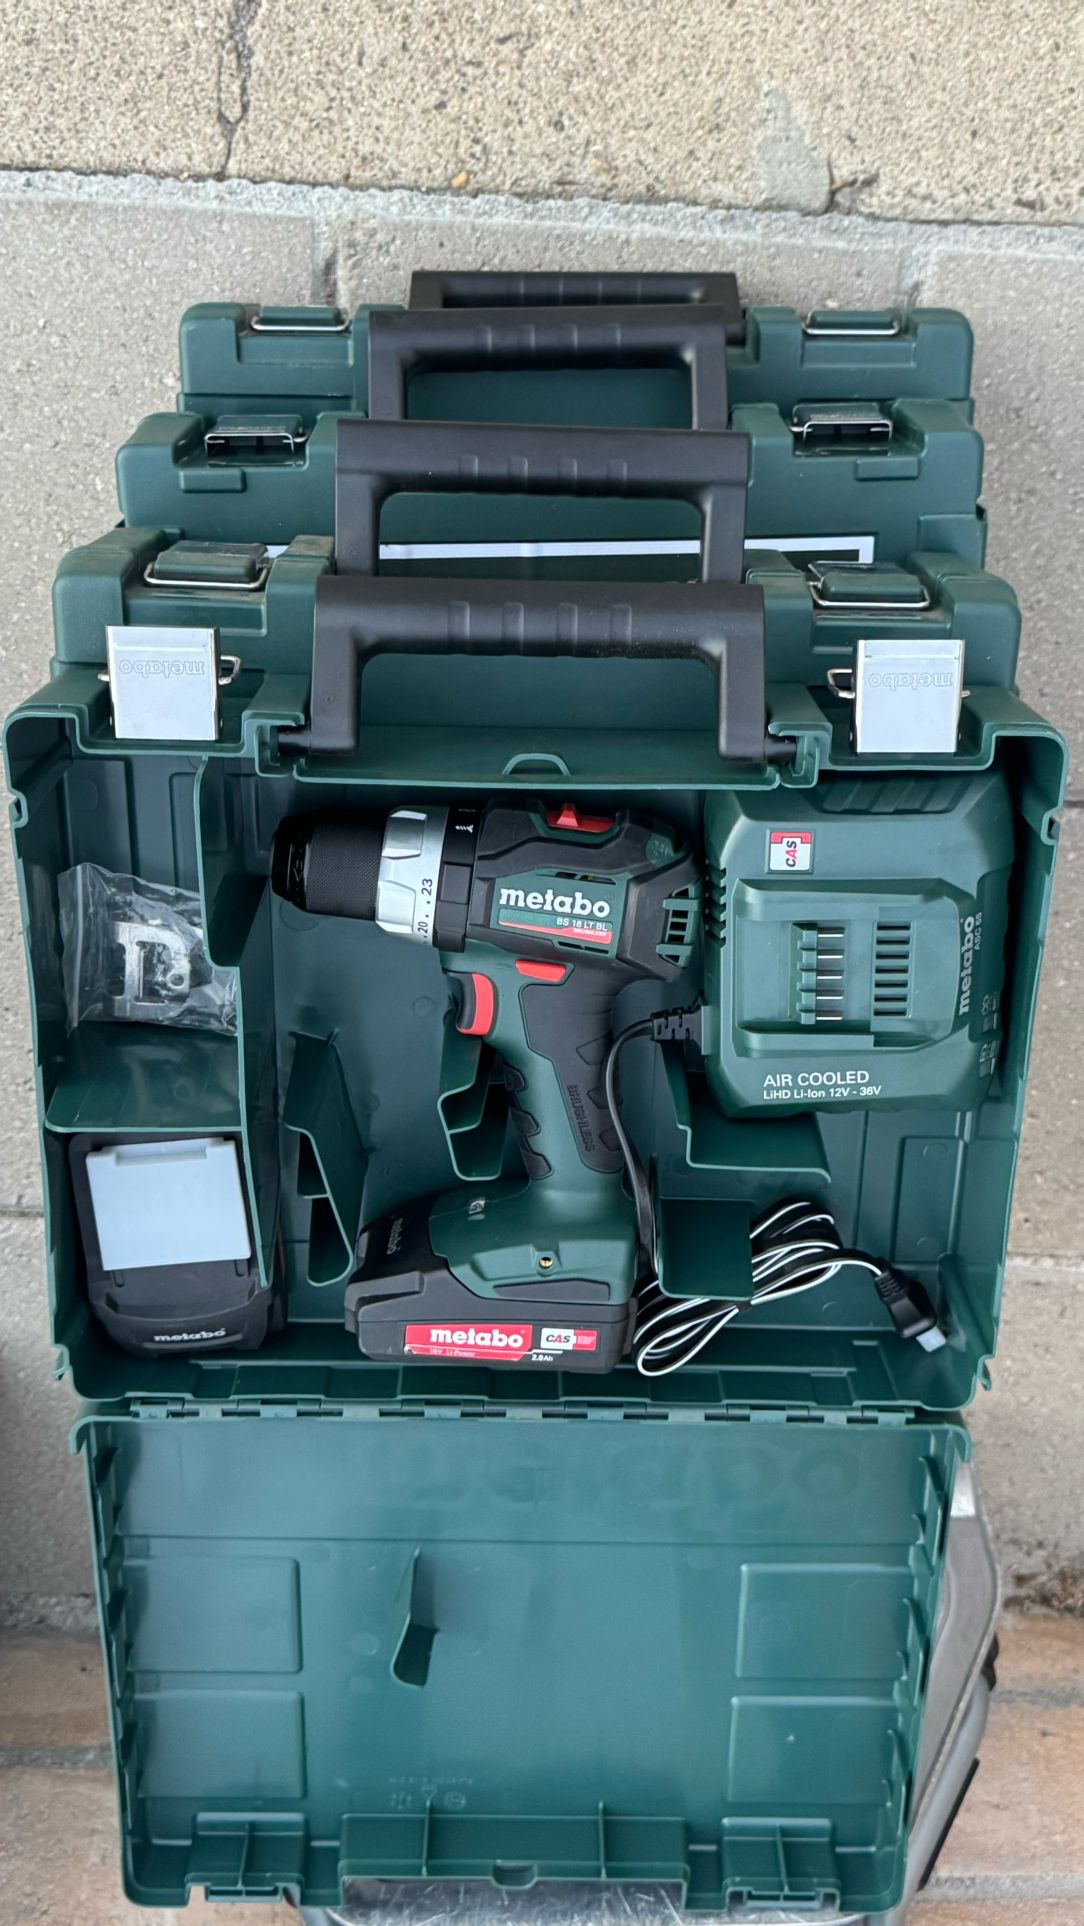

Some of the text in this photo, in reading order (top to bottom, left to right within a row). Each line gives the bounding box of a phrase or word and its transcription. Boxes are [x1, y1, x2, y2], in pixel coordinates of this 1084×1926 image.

[120, 660, 205, 679] metabo
[869, 672, 953, 691] metabo
[786, 839, 798, 868] CAS
[499, 887, 611, 918] metabo
[556, 917, 608, 931] BS 18 LT BL
[959, 916, 974, 1016] metabo
[763, 1071, 870, 1088] AIR COOLED
[763, 1089, 791, 1099] LiHD
[829, 1087, 850, 1098] 12V
[859, 1086, 881, 1096] 36V
[155, 1330, 225, 1340] metabo
[430, 1326, 525, 1348] metabo
[545, 1333, 571, 1344] CAS
